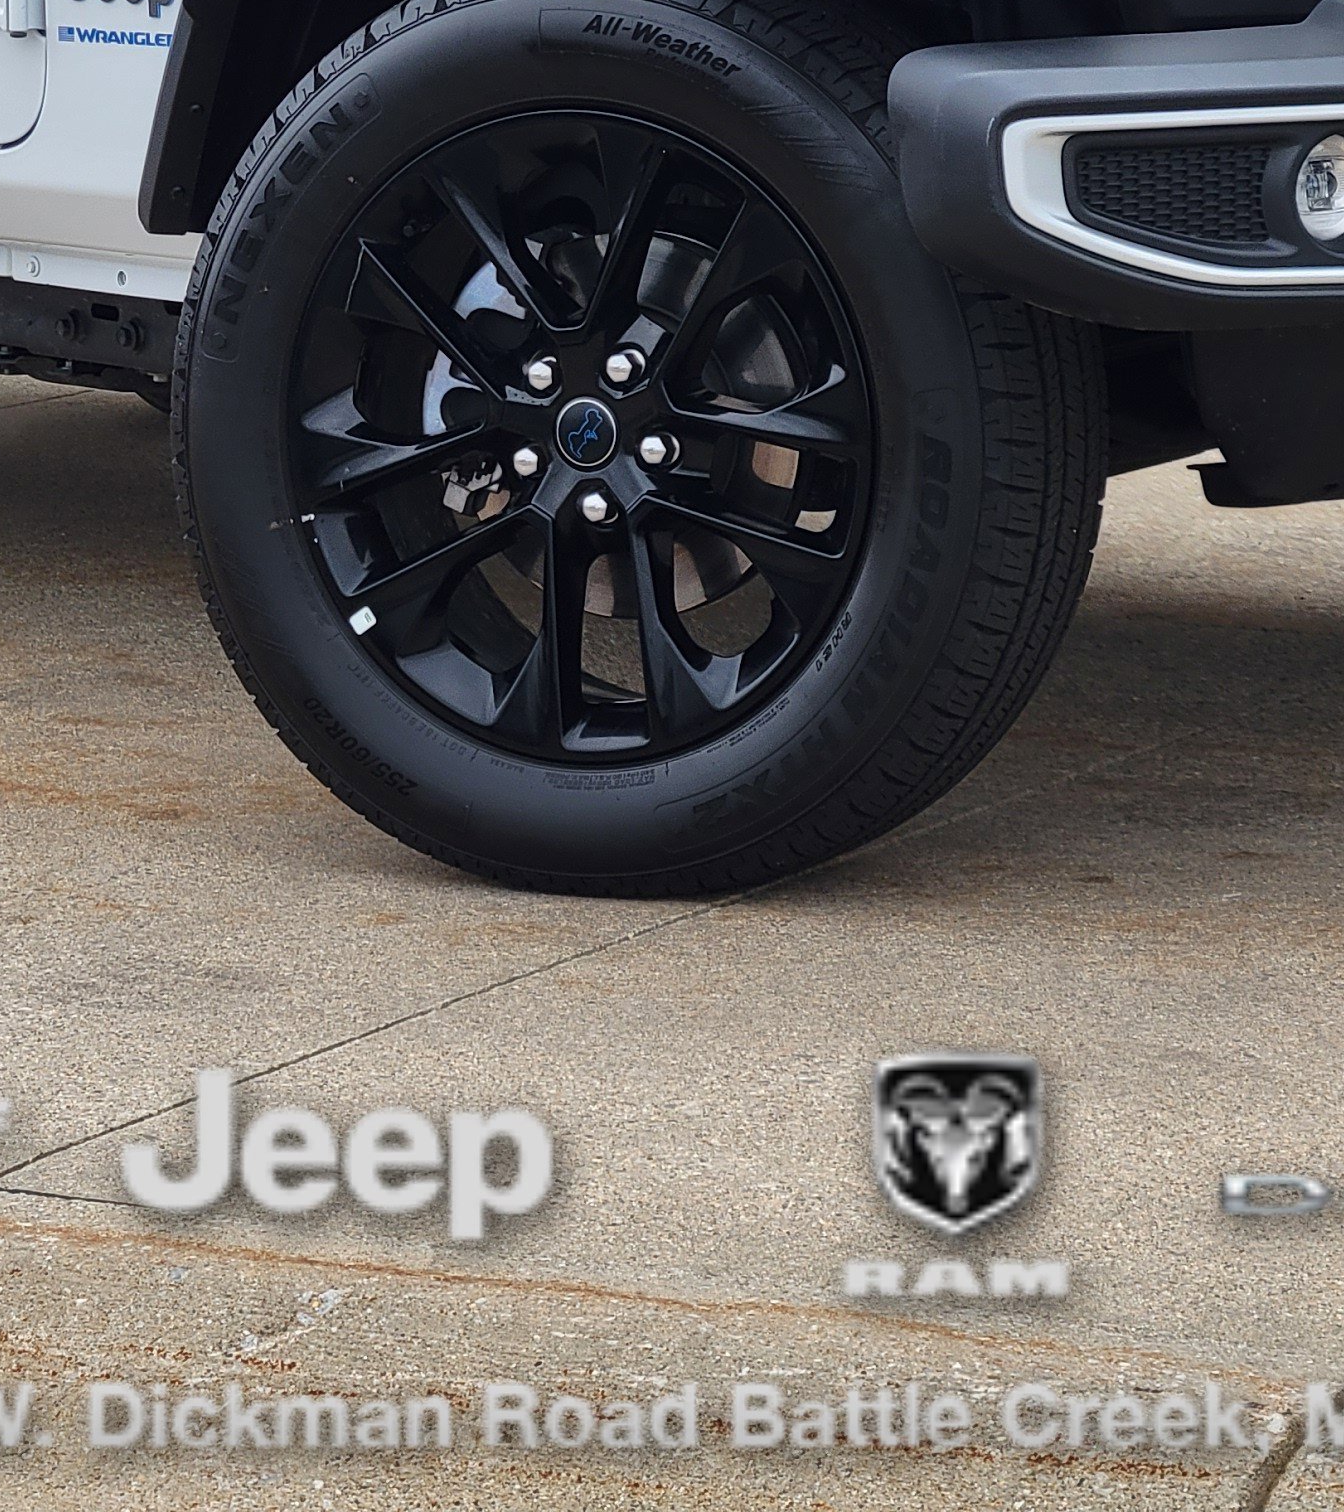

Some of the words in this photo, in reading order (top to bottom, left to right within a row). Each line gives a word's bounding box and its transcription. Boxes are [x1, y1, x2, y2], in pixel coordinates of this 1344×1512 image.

[582, 13, 743, 79] All-Weather
[212, 102, 355, 326] NEXEN
[305, 695, 419, 798] 255/60R20
